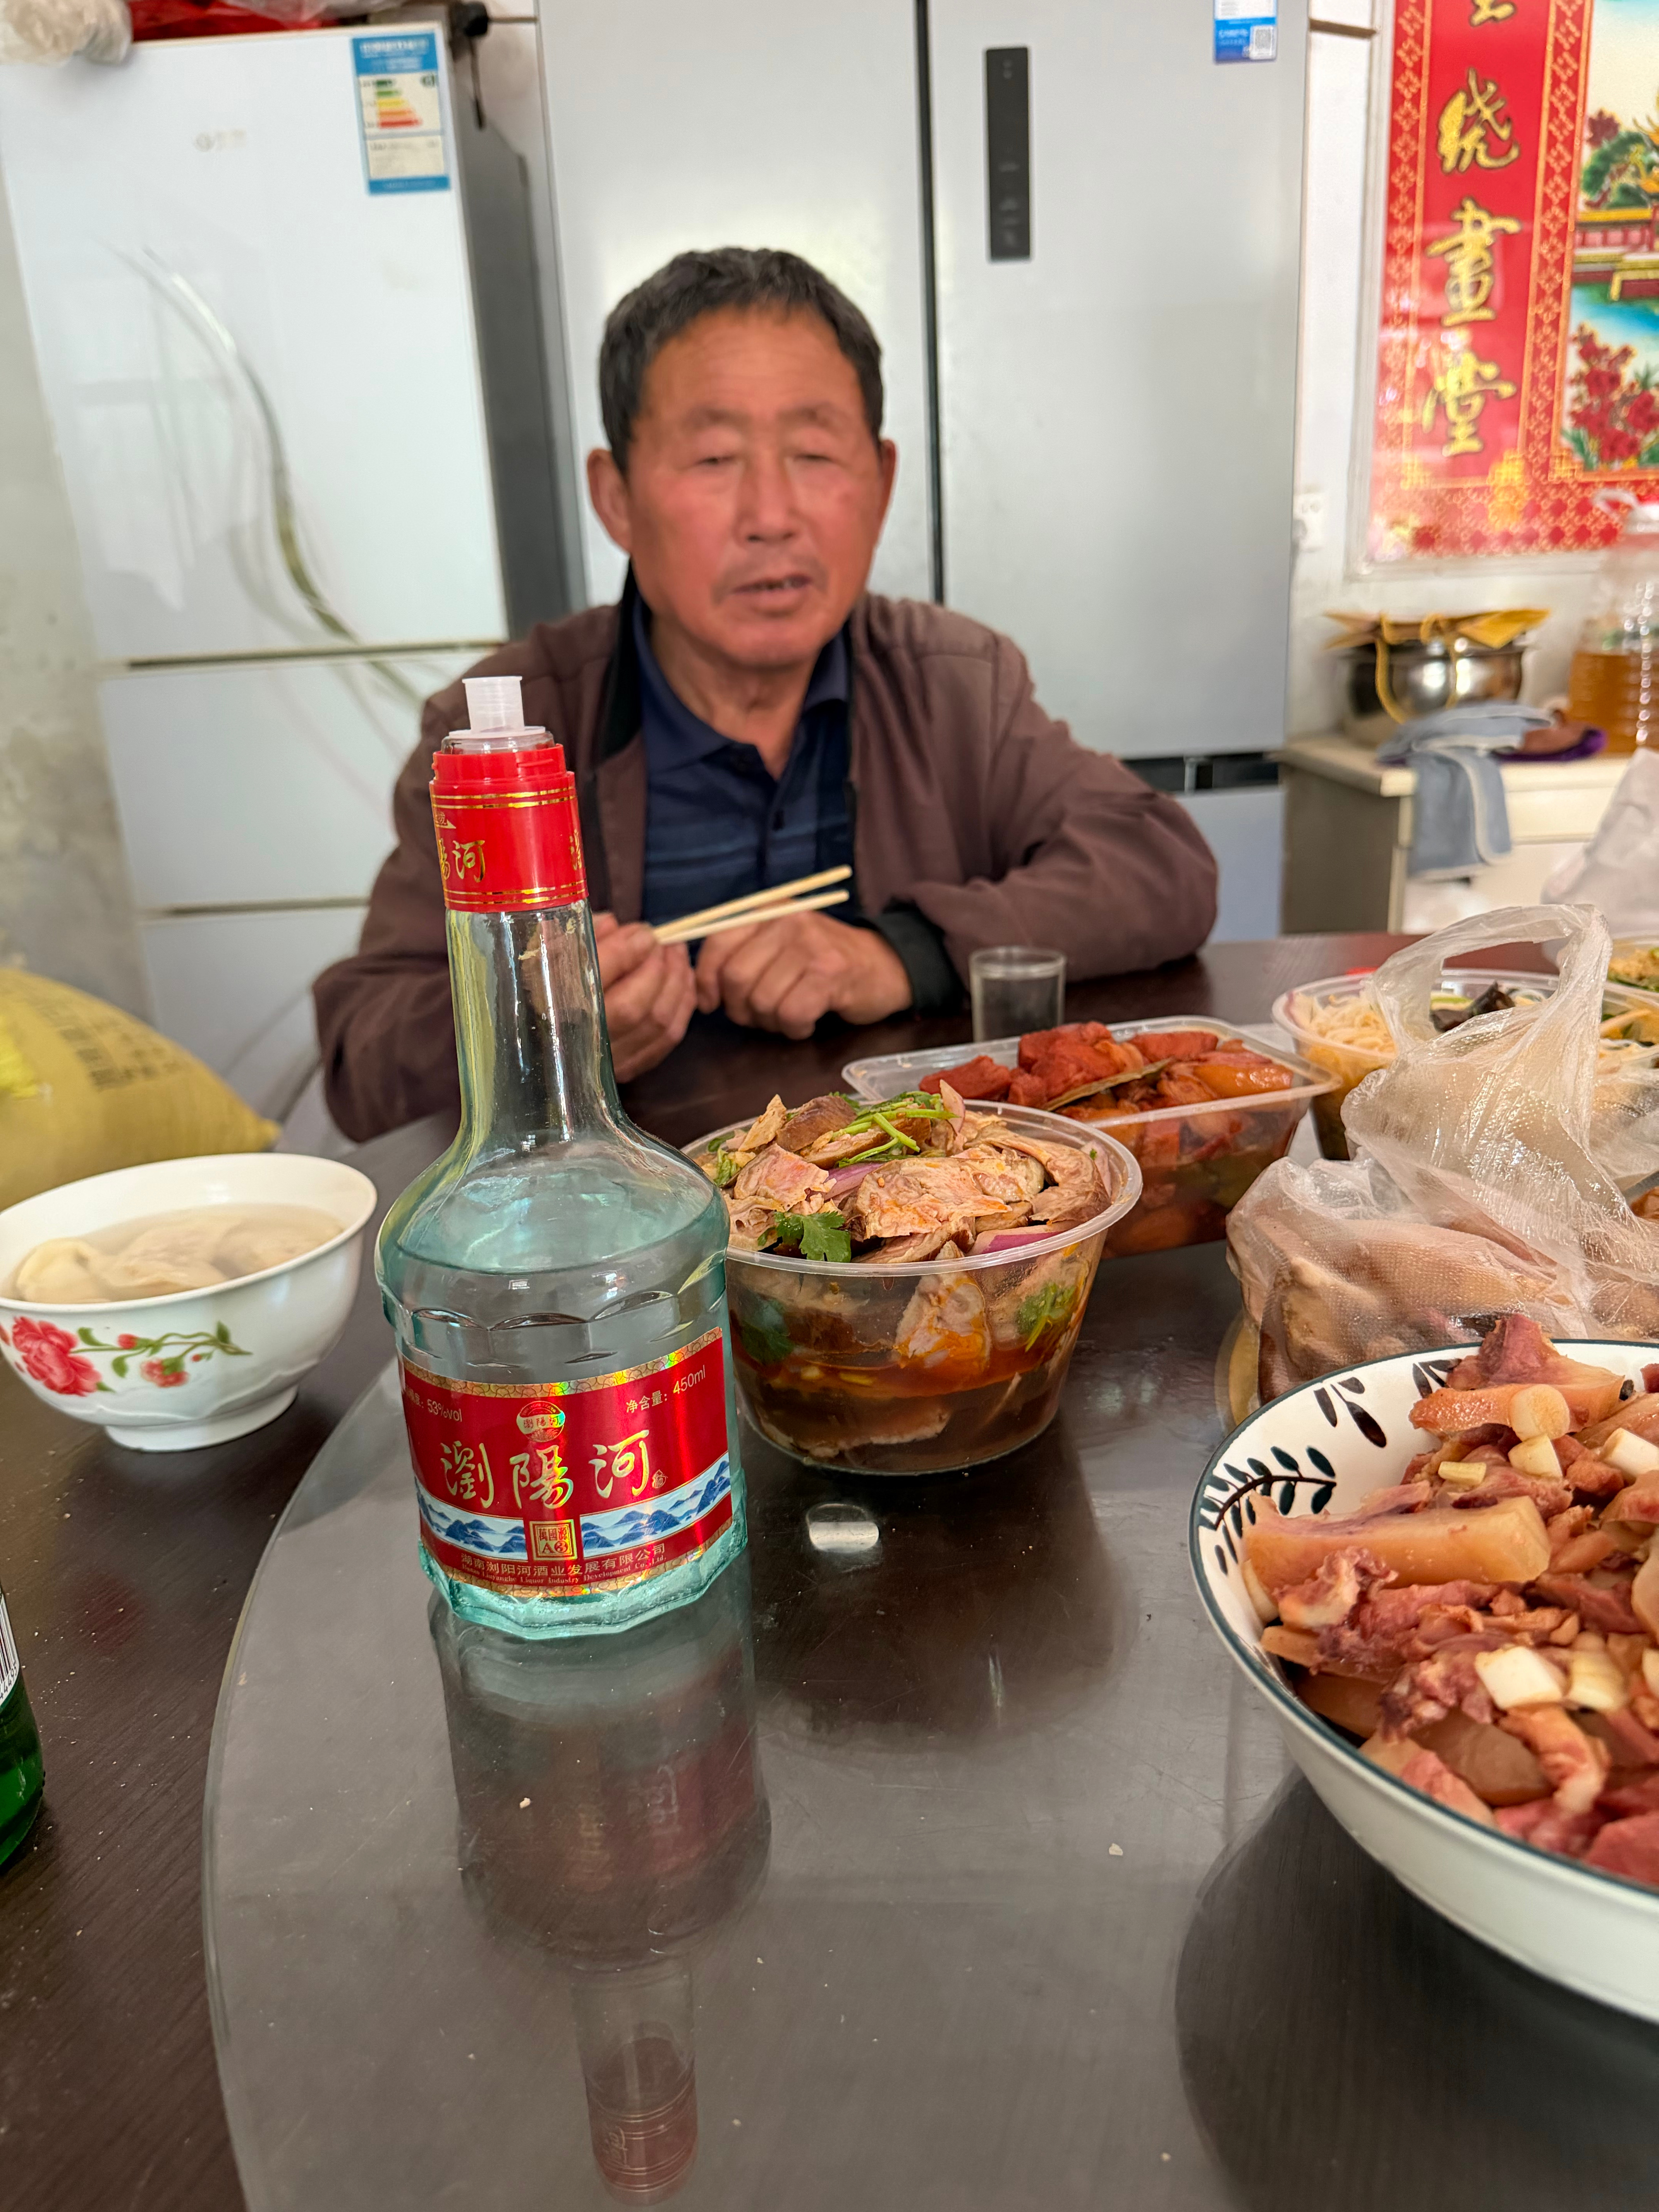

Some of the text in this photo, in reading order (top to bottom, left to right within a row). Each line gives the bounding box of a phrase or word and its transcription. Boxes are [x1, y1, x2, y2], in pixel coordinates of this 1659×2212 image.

[626, 1364, 706, 1413] 净含量: 450ml
[427, 1398, 462, 1422] 53%vol
[461, 1543, 665, 1576] 湖南浏阳河酒业发展有限公司
[583, 1565, 631, 1582] Development
